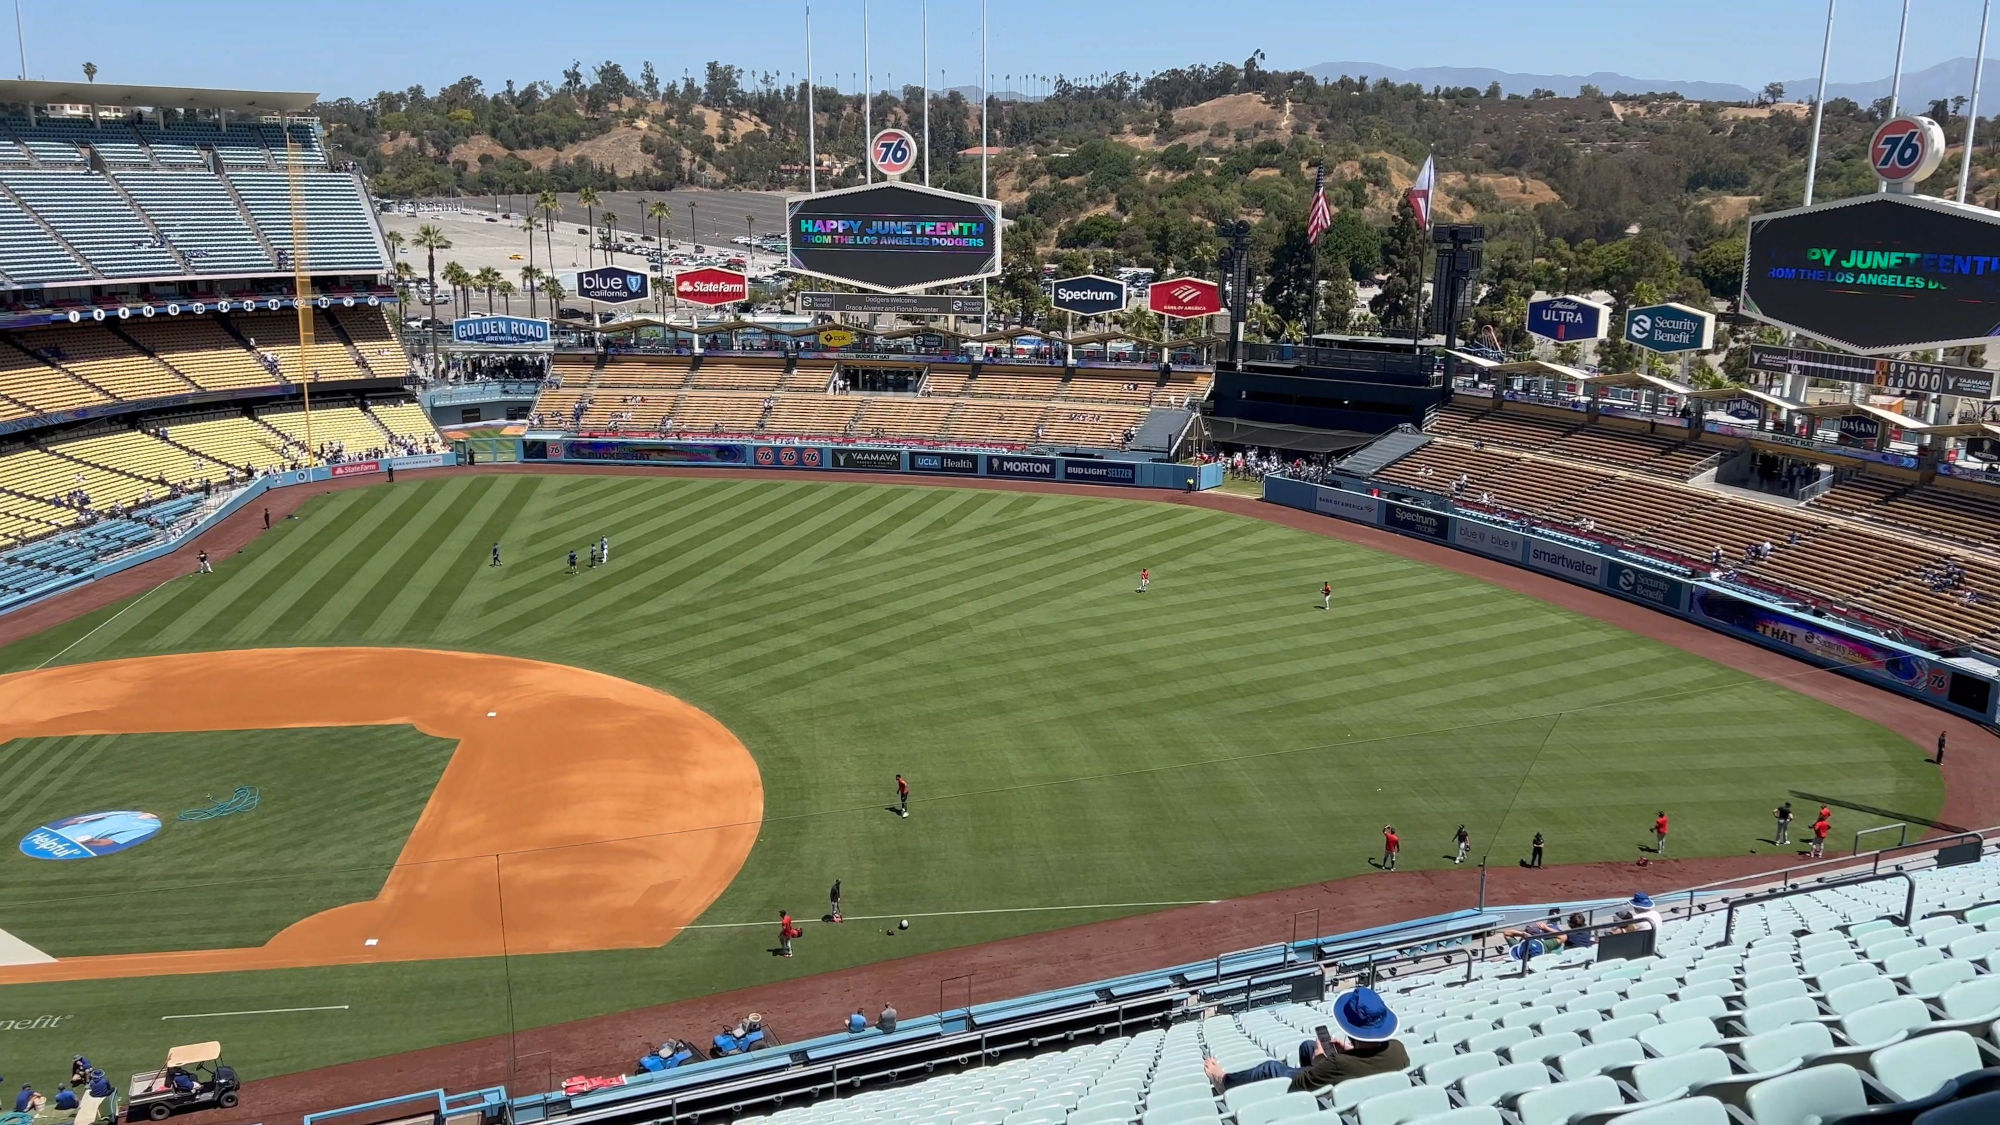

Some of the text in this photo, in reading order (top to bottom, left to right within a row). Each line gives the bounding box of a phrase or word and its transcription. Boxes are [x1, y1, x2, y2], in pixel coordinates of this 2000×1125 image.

[878, 139, 909, 164] 76
[1877, 131, 1920, 168] 76
[800, 219, 984, 236] HAPPY JUNETEENTH
[802, 235, 985, 247] FROM THE LOS ANGELES DODGERS
[583, 273, 622, 290] blue
[693, 280, 744, 293] StateFarm
[1768, 267, 1797, 280] ROM
[1798, 268, 1824, 281] THE
[1826, 270, 1854, 283] LOS
[1856, 273, 1925, 289] ANGELES
[865, 296, 890, 304] Dodgers
[1057, 288, 1114, 302] Spectrum
[1542, 309, 1584, 324] ULTRA
[1655, 316, 1698, 333] Security
[458, 321, 544, 339] GOLDEN ROAD
[1653, 329, 1690, 344] Benefit
[1907, 371, 1916, 388] 0
[1918, 372, 1928, 390] 0
[1930, 374, 1940, 391] 0
[1727, 401, 1740, 414] JIM
[1741, 400, 1759, 418] BEAM
[1841, 420, 1877, 434] DASANI
[550, 446, 560, 455] 76
[758, 451, 772, 461] 76
[782, 451, 795, 462] 76
[804, 452, 817, 462] 76
[917, 458, 973, 469] UCLA Health
[1003, 461, 1050, 474] MORTON
[1067, 466, 1133, 479] BUD LIGHT SELTZER
[1395, 507, 1436, 526] Spectrum
[1460, 527, 1477, 540] blue
[1491, 535, 1509, 548] blue
[1532, 548, 1598, 576] smartwater
[1637, 573, 1670, 593] Security
[1636, 585, 1664, 602] Benefit
[1771, 627, 1797, 645] HAT
[1931, 675, 1945, 689] 76
[0, 1013, 64, 1032] nefit
